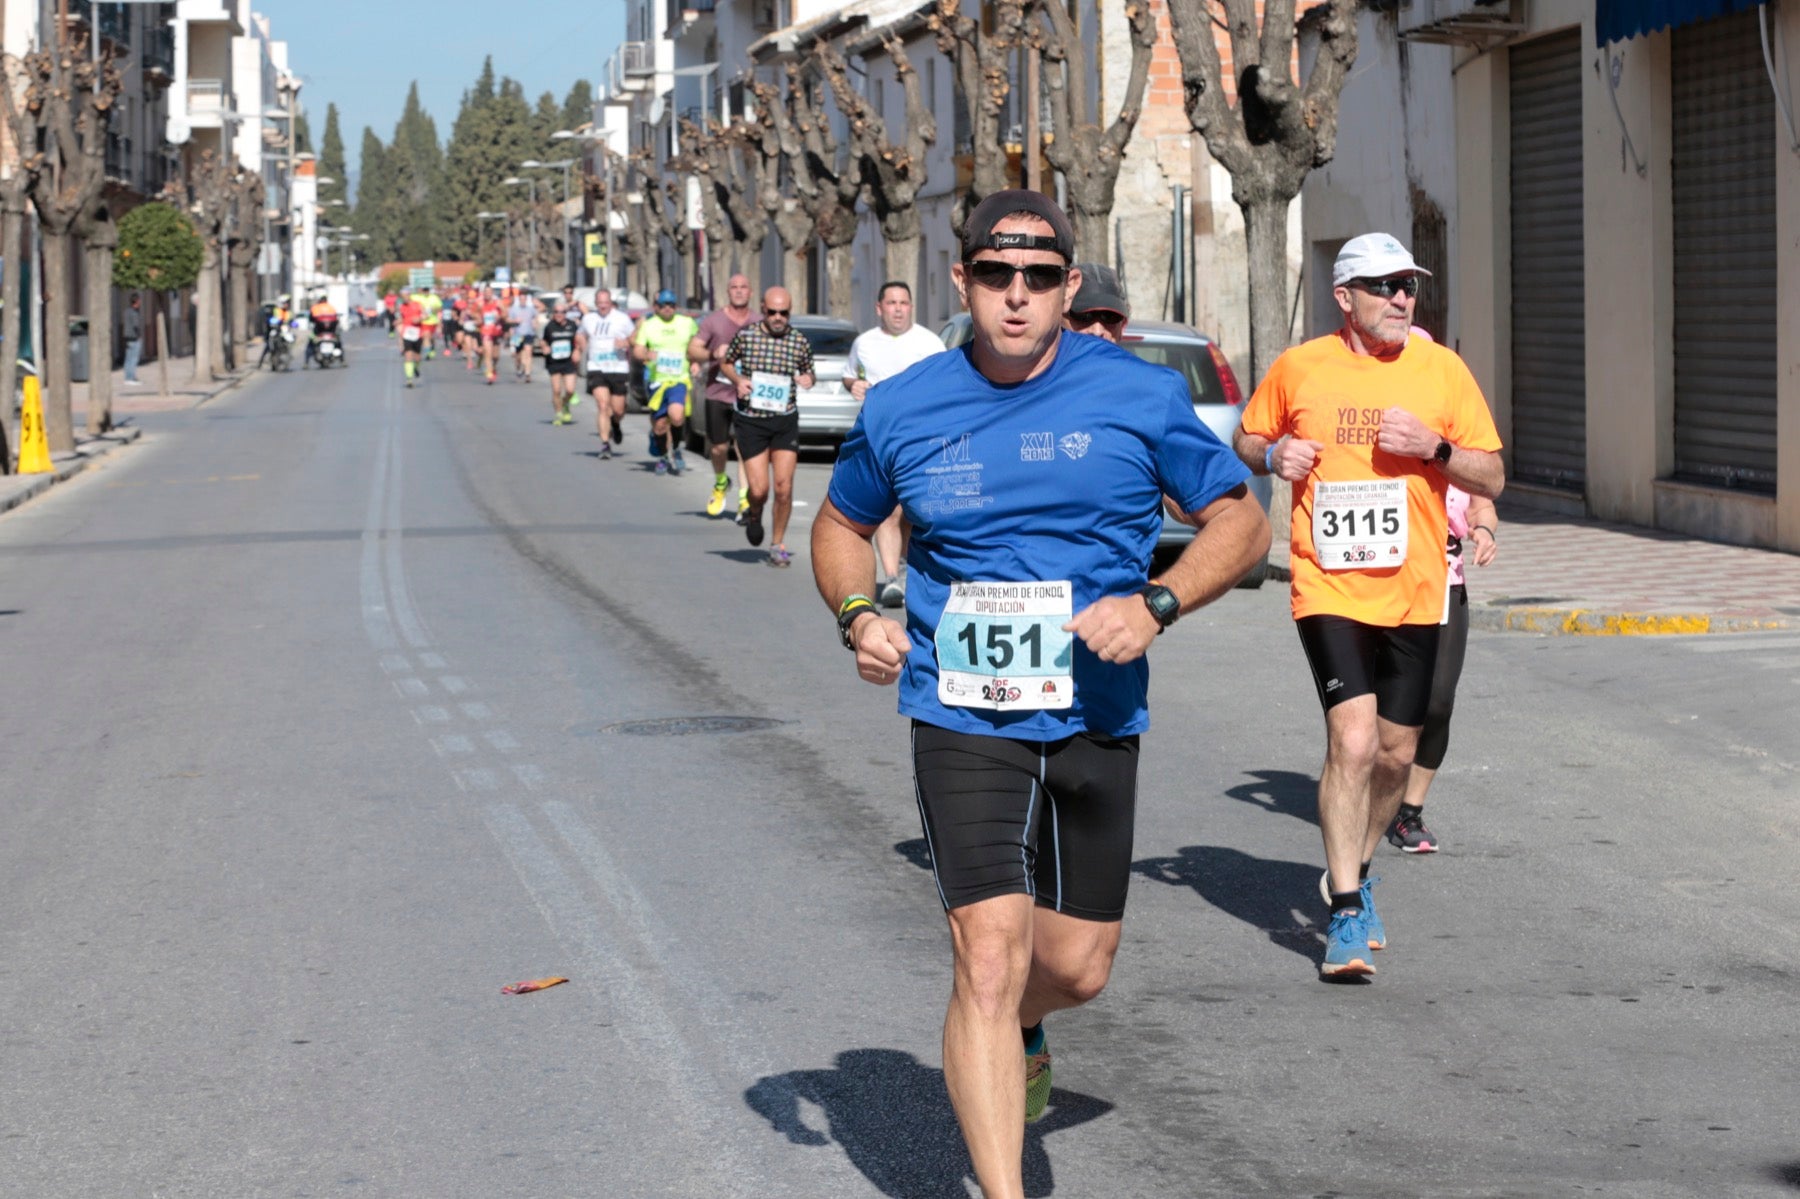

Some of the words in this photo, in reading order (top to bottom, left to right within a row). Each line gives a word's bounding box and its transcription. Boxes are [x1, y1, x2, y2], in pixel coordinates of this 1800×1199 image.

[757, 384, 784, 400] 250
[1337, 407, 1357, 426] YO
[1361, 408, 1385, 426] SO
[1020, 432, 1054, 449] XVI
[1020, 448, 1055, 461] 2013
[1347, 484, 1370, 493] PREMIO
[1379, 483, 1399, 491] FONDO
[1322, 508, 1400, 537] 3115
[987, 586, 1018, 599] PREMIO
[1021, 586, 1032, 598] DE
[975, 600, 1025, 613] DIPUTACIÓN
[958, 622, 1041, 669] 151
